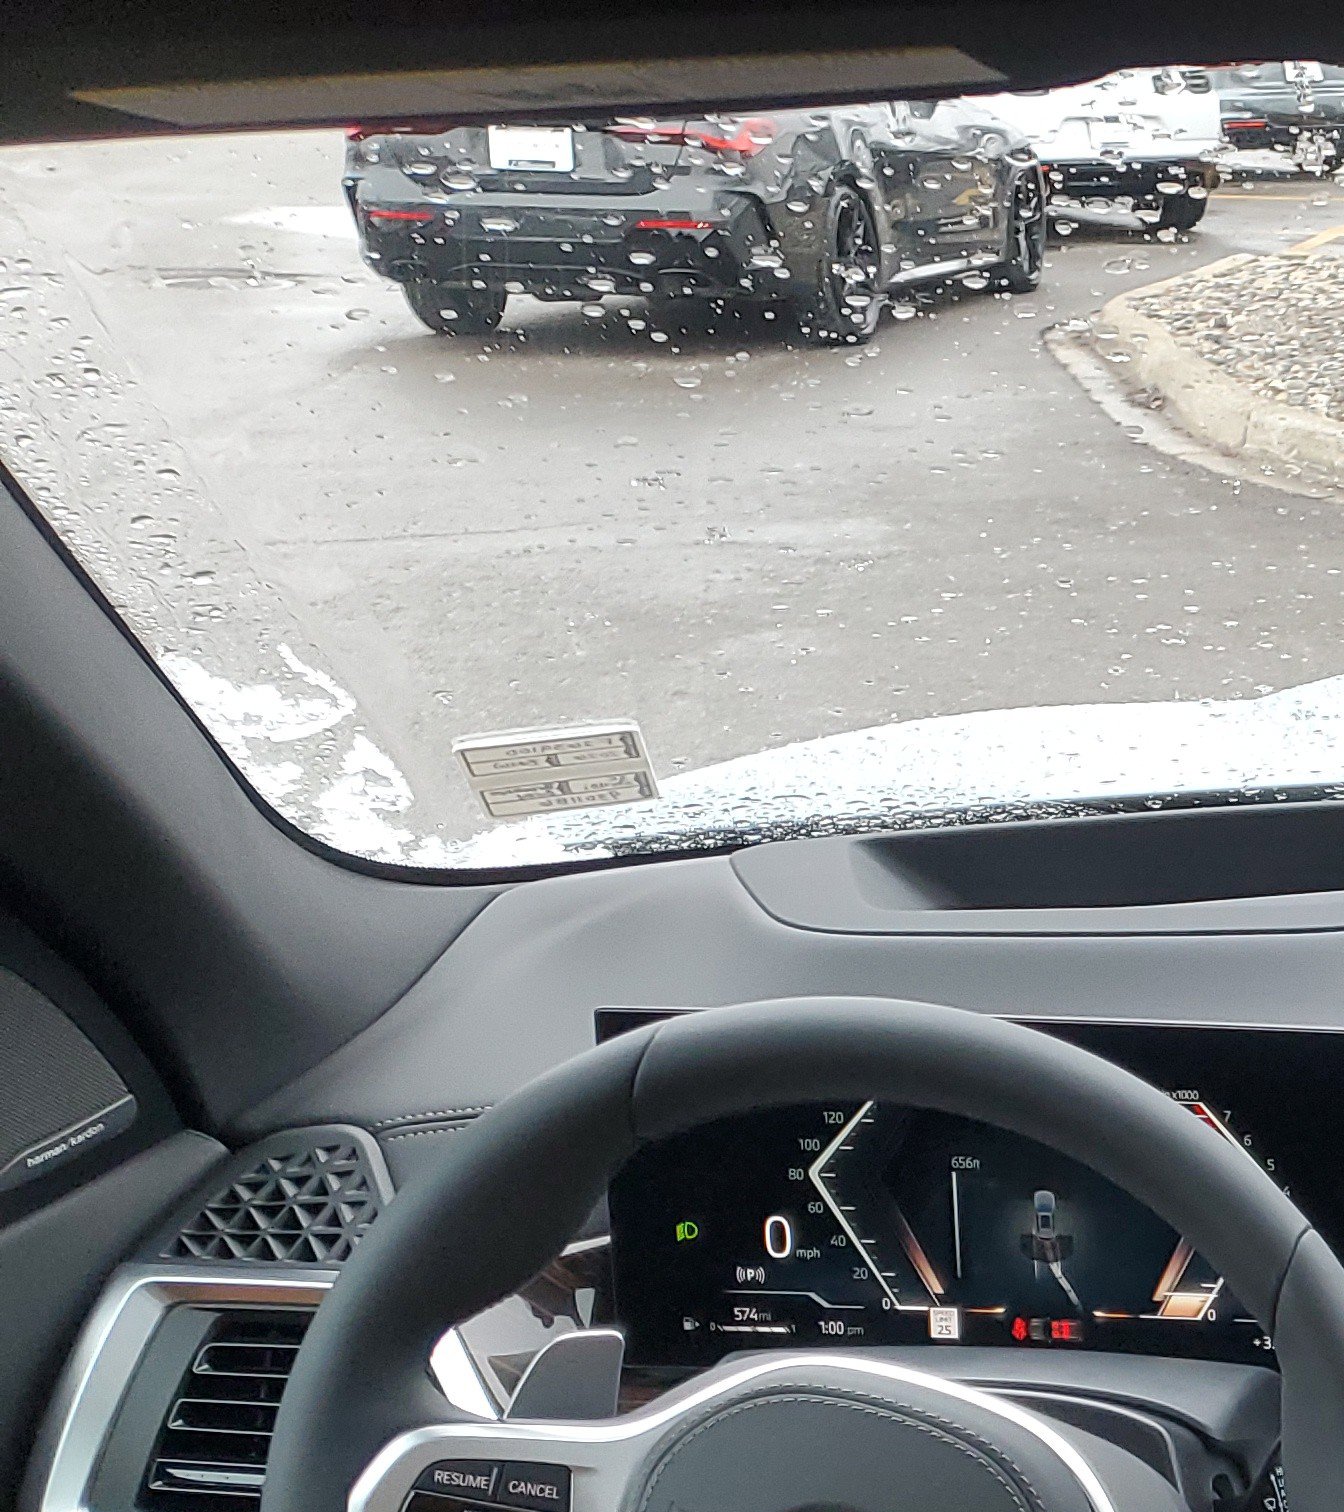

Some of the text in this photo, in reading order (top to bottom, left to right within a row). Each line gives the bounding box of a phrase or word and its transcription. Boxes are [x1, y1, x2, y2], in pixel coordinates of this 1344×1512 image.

[823, 1112, 844, 1124] 120
[1223, 1110, 1231, 1122] 7
[799, 1139, 820, 1151] 100
[1243, 1135, 1252, 1146] 6
[1266, 1159, 1275, 1171] 5
[788, 1168, 805, 1181] 80
[808, 1202, 824, 1214] 60
[765, 1216, 820, 1260] 0 mph
[831, 1235, 846, 1246] 40
[853, 1268, 868, 1279] 20
[882, 1298, 891, 1310] 0
[1207, 1309, 1216, 1321] 0
[818, 1321, 844, 1335] 1:00
[938, 1325, 951, 1335] 25
[433, 1469, 490, 1490] RESUME
[508, 1481, 560, 1499] CANCEL
